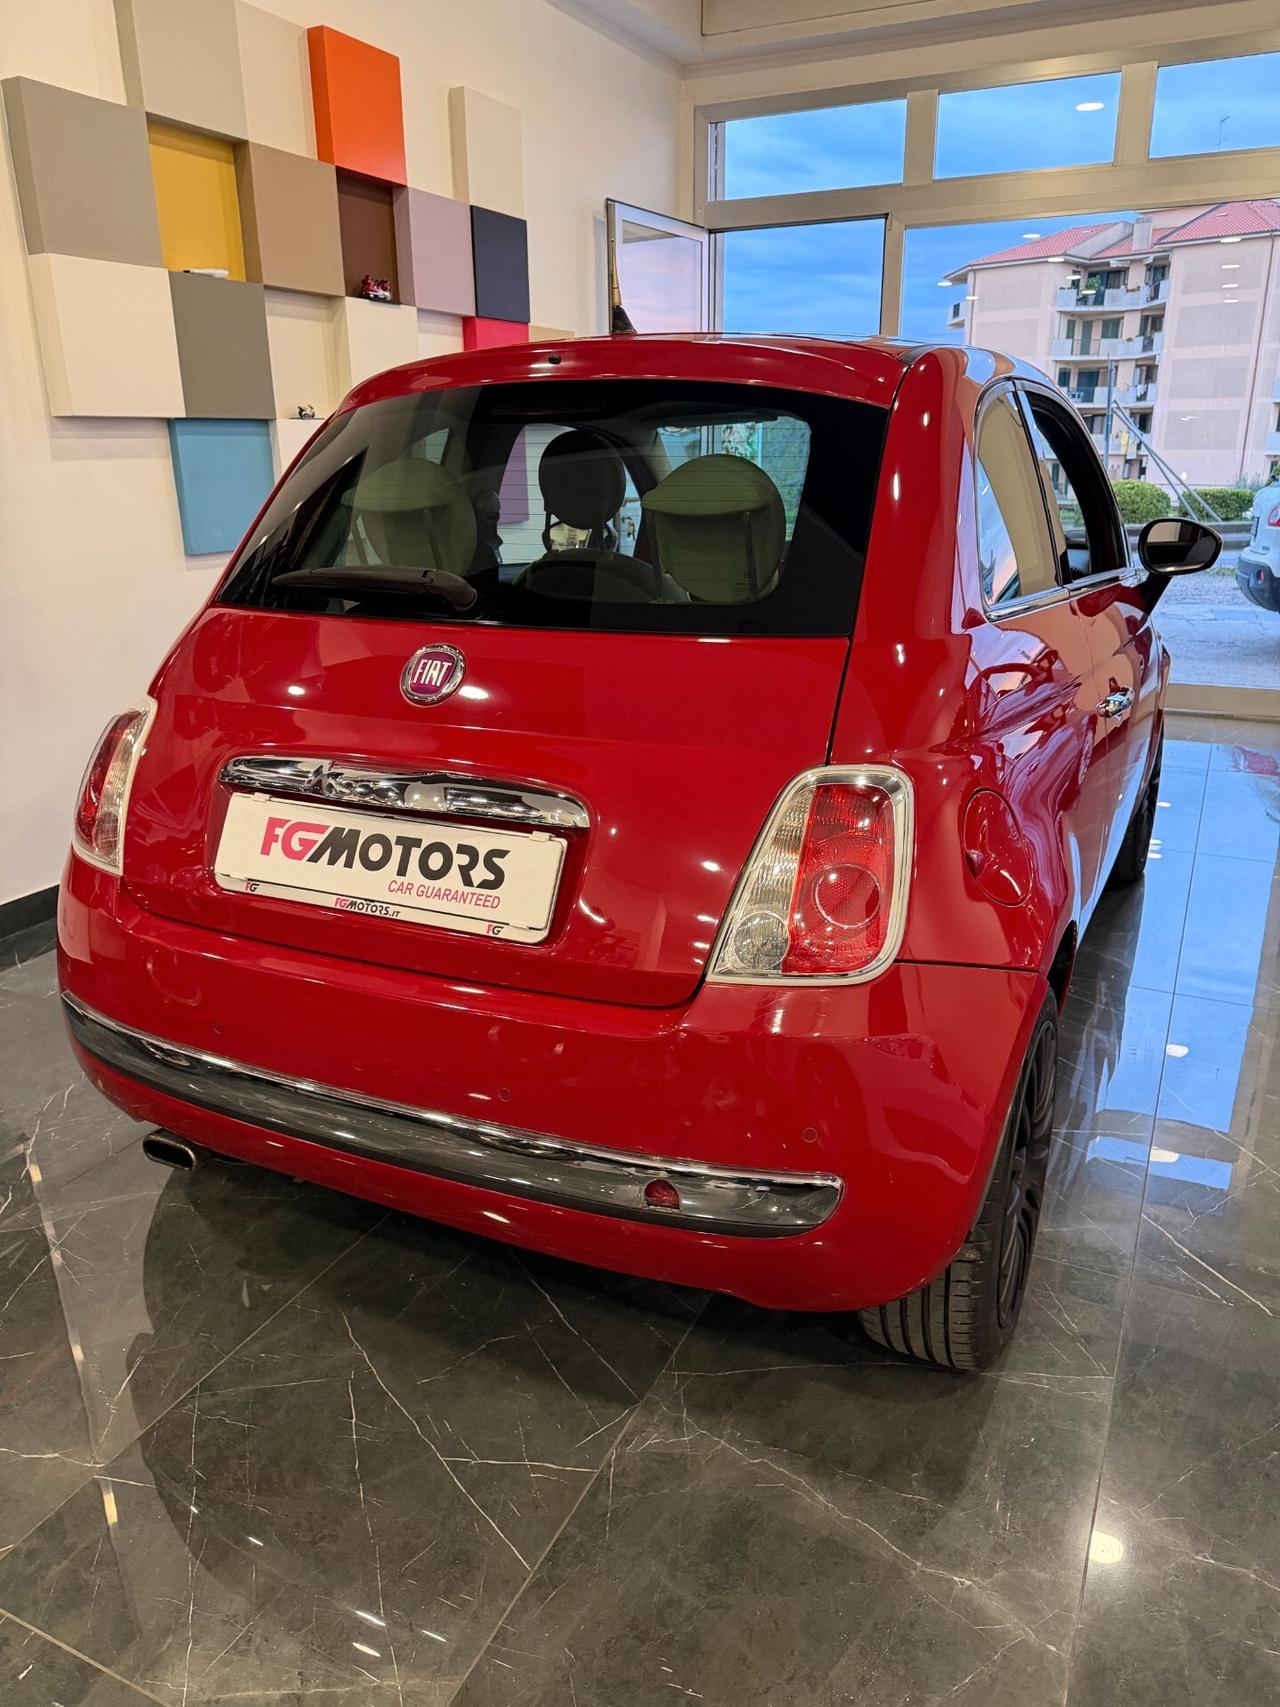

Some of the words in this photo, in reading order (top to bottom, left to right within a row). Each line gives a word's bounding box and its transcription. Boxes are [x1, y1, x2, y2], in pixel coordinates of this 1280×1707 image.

[412, 659, 453, 687] FIAT
[245, 882, 260, 893] FG
[388, 879, 414, 896] CAR
[416, 884, 501, 909] GUARANTEED
[486, 923, 504, 936] FG
